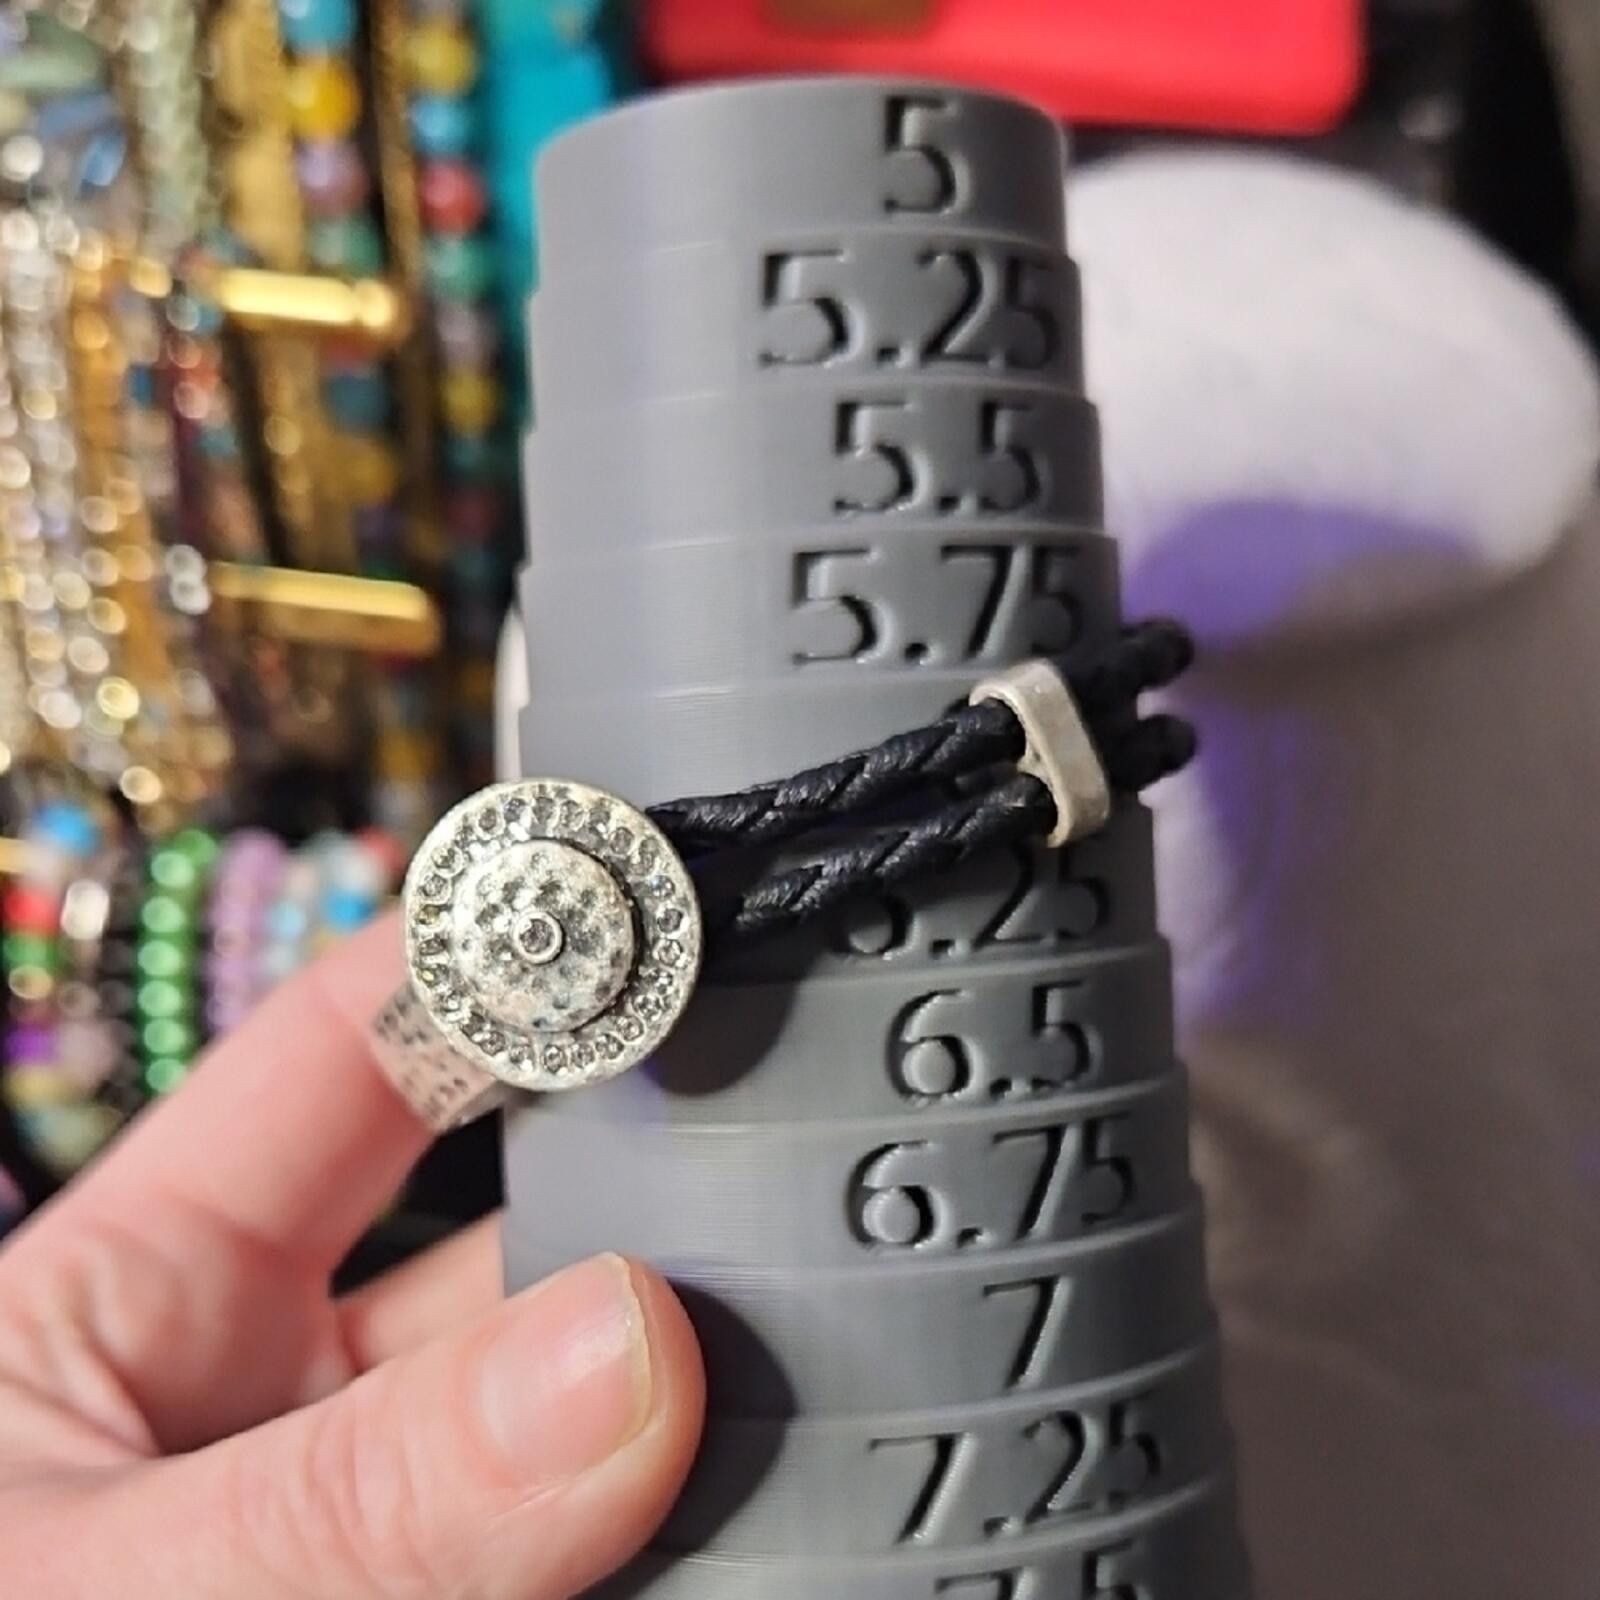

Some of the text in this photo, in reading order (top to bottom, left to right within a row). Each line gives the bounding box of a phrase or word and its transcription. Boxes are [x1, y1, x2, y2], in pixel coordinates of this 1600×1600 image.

[884, 94, 969, 214] 5
[758, 248, 1062, 369] 5.25
[833, 401, 1049, 514] 5.5
[790, 543, 1083, 665] 5.75
[887, 980, 1102, 1103] 6.5
[845, 1112, 1137, 1250] 6.75
[982, 1275, 1073, 1390] 7
[868, 1401, 1162, 1546] 7.25
